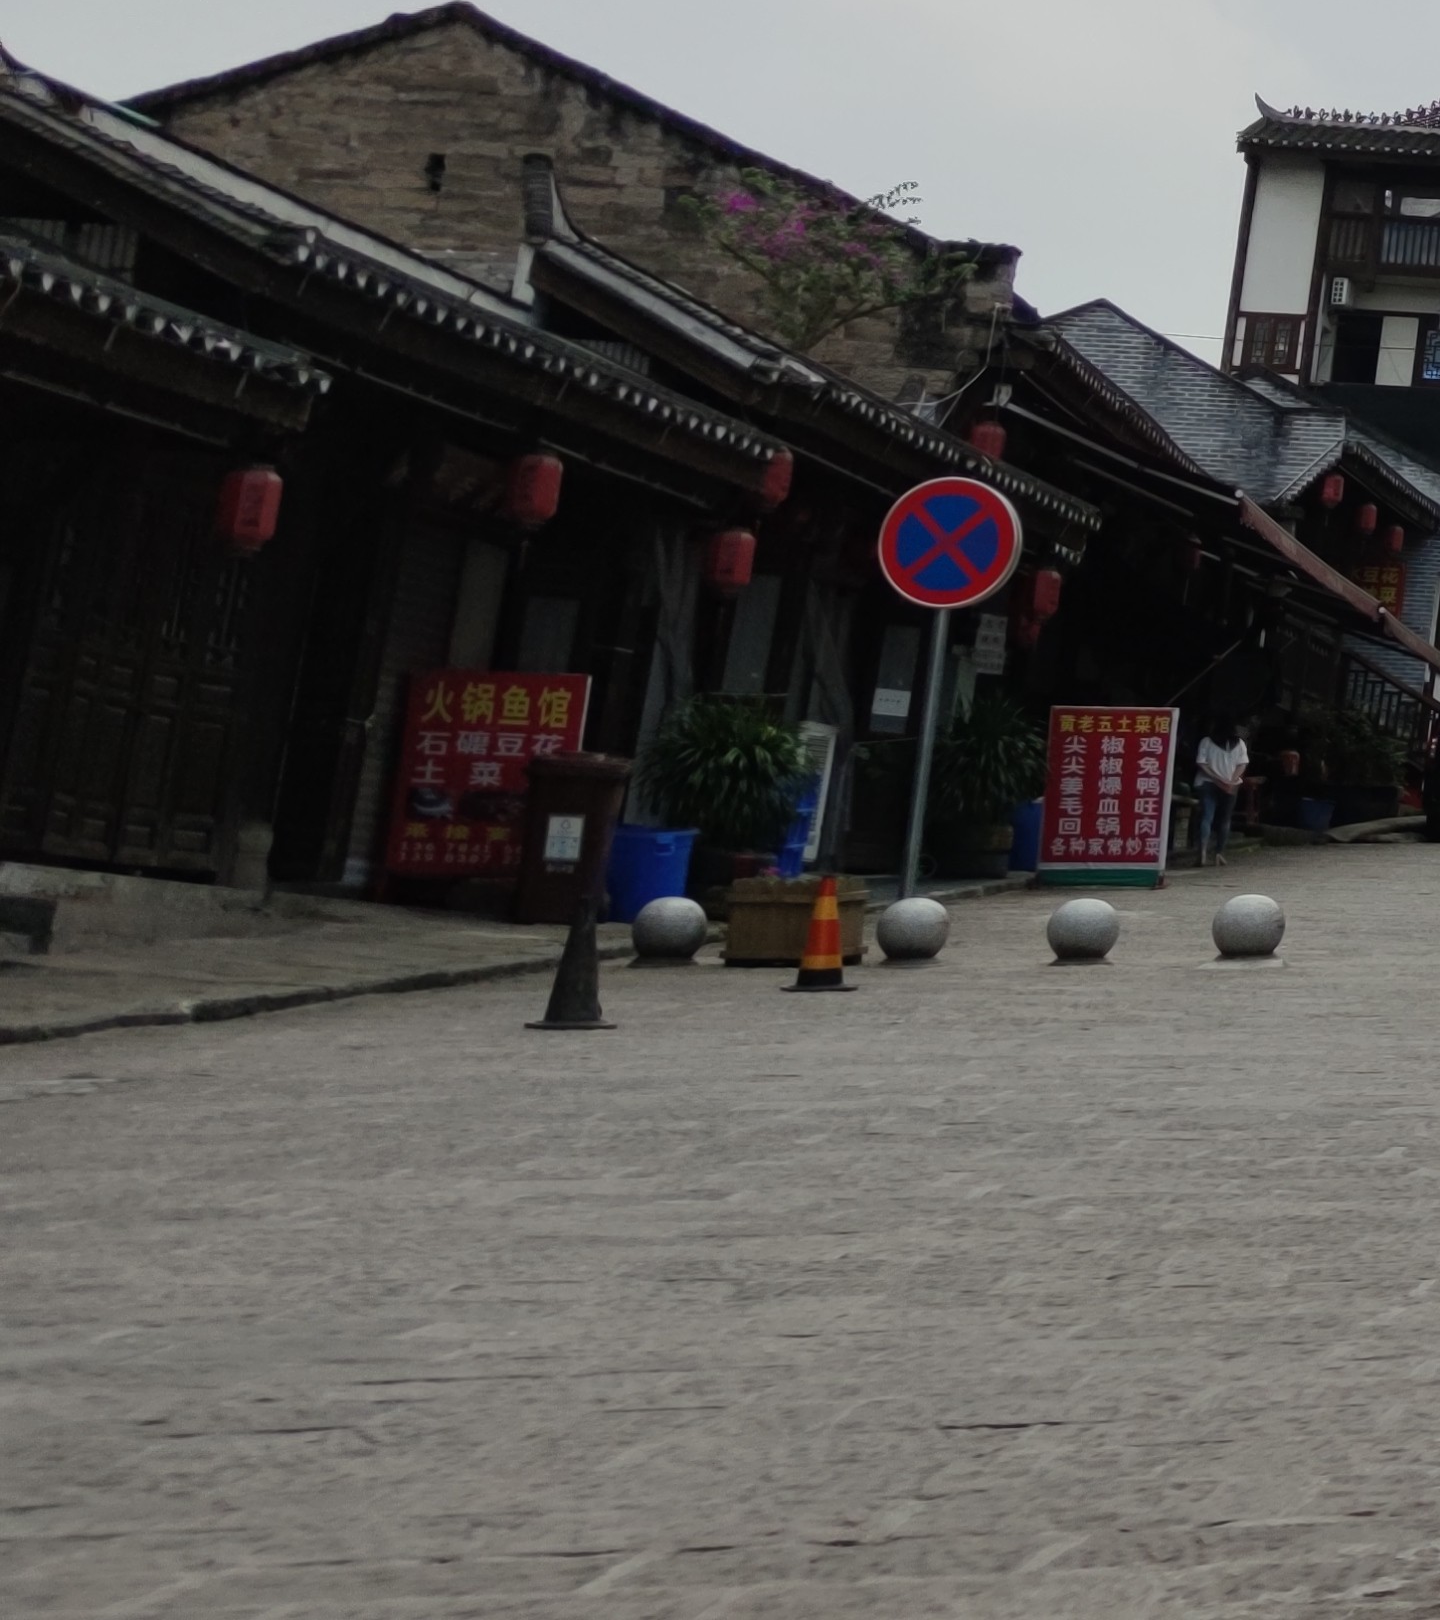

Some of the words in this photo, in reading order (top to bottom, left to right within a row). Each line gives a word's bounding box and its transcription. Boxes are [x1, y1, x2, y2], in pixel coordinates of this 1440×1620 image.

[420, 680, 573, 729] 火锅鱼馆
[1062, 734, 1164, 755] 尖椒鸡
[1060, 755, 1163, 776] 尖椒兔
[1058, 796, 1160, 816] 毛血旺
[1057, 816, 1158, 836] 回锅肉
[1050, 836, 1161, 857] 各种家常炒菜
